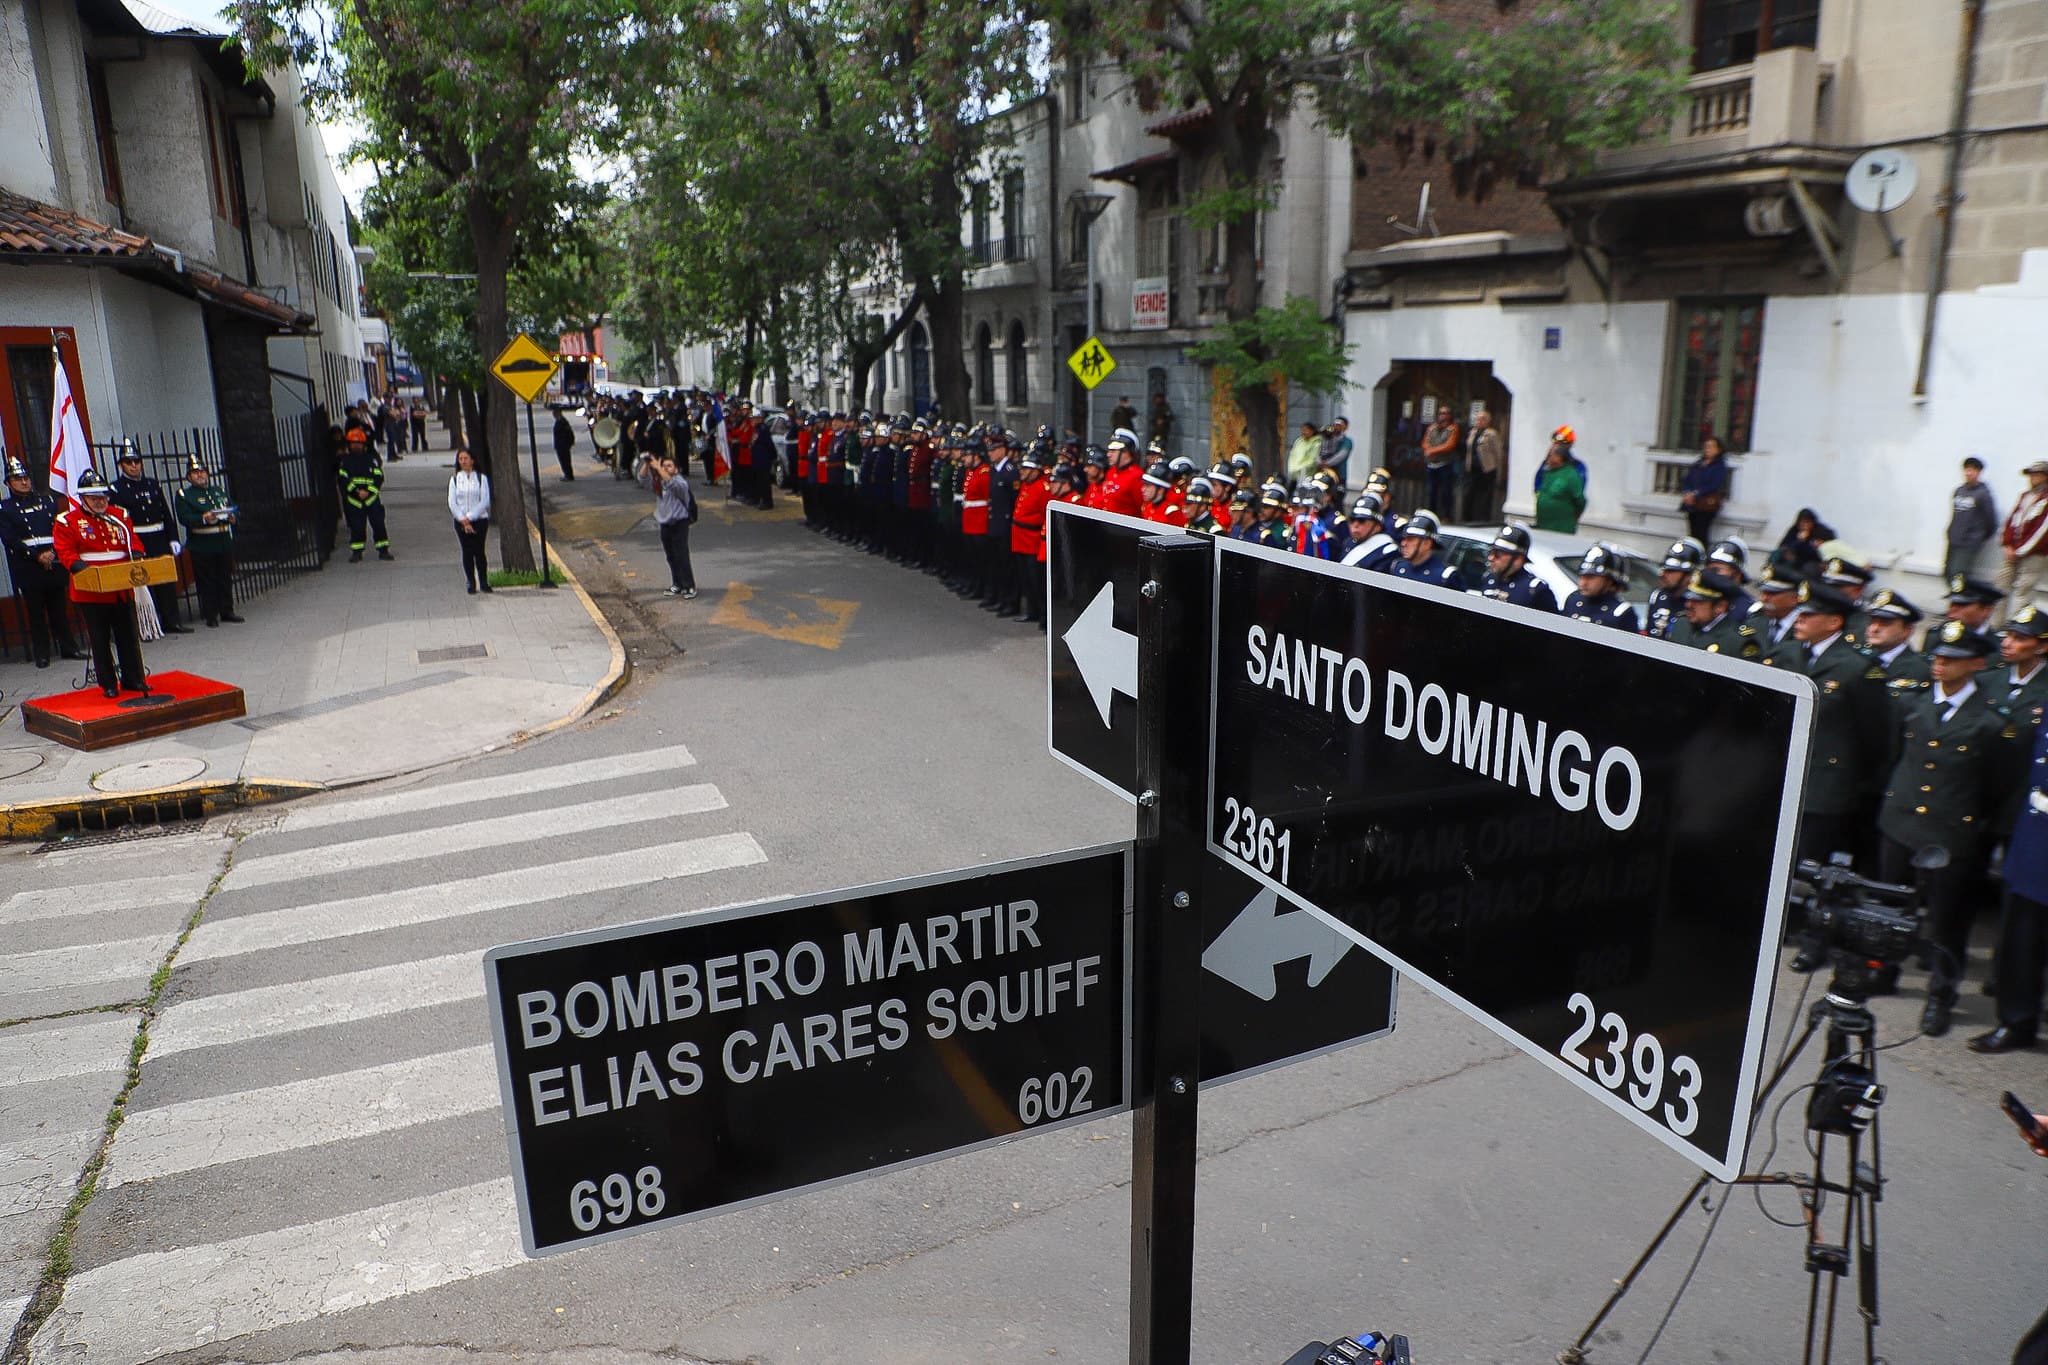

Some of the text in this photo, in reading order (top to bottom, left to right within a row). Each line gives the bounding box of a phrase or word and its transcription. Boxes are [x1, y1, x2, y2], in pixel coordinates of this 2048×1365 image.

[1134, 291, 1166, 314] VENDE
[1246, 624, 1642, 831] SANTO DOMINGO
[1222, 796, 1292, 885] 2361
[517, 899, 1042, 1050] BOMBERO MARTIR
[528, 955, 1101, 1127] ELIAS CARES SQUIFF
[1018, 1066, 1093, 1125] 602
[1560, 992, 1703, 1137] 2393
[569, 1165, 666, 1232] 698
